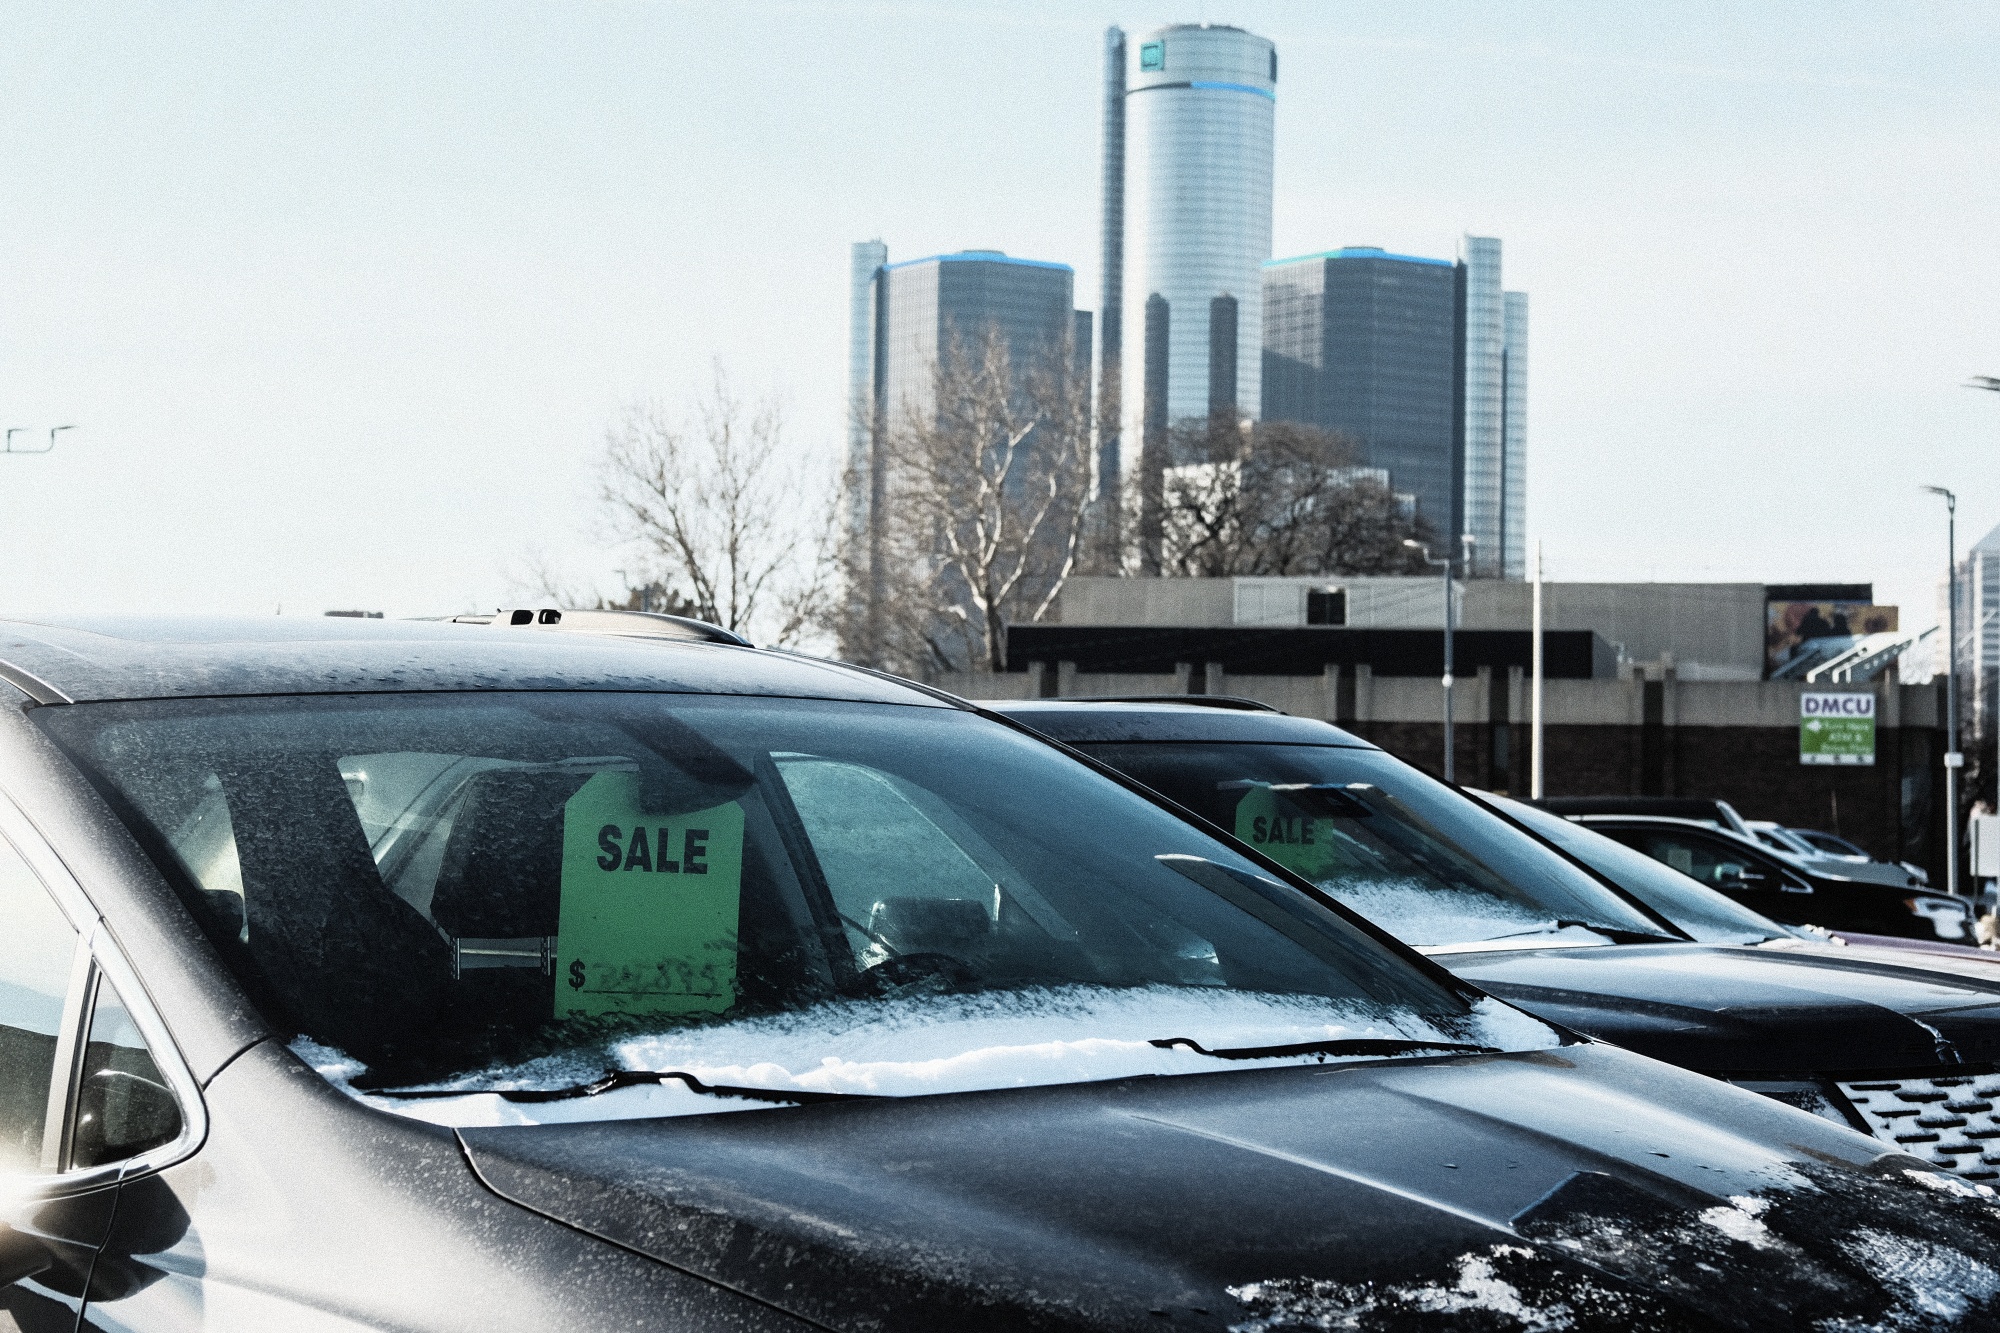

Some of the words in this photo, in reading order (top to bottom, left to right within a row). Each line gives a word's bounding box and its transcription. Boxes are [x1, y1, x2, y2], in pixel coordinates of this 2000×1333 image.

[1805, 697, 1871, 714] DMCU
[1252, 816, 1315, 845] SALE
[596, 824, 710, 875] SALE
